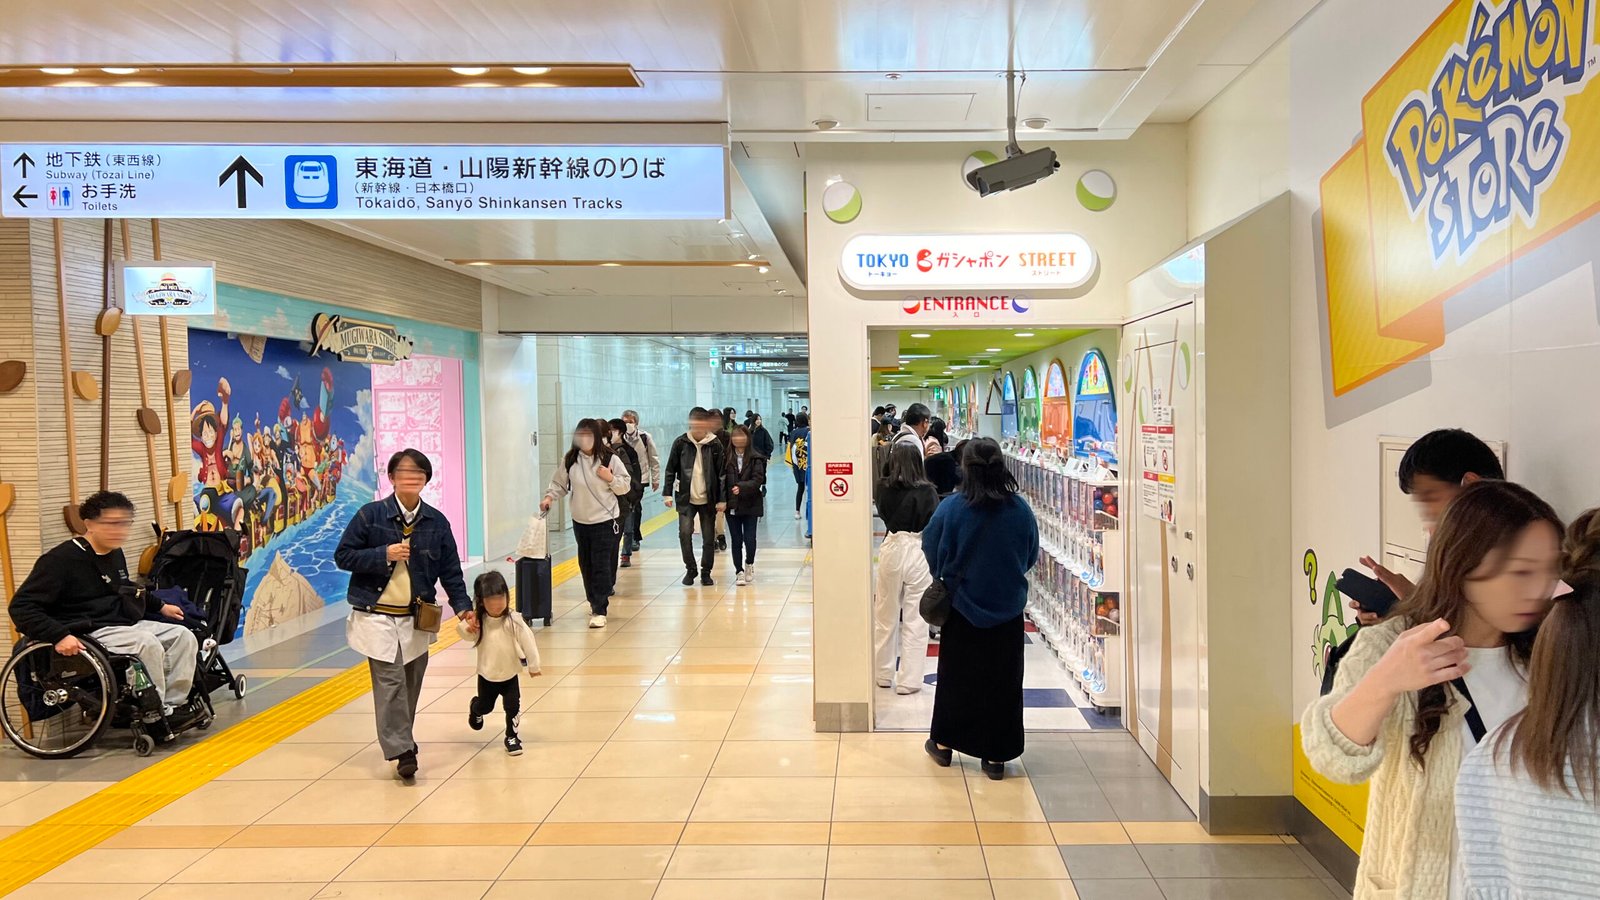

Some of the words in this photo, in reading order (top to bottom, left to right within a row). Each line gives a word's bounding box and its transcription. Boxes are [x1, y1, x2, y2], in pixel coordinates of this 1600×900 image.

[46, 170, 87, 180] Subway
[128, 170, 155, 180] Line)
[355, 156, 666, 180] 東海道・山陽新幹線のりば
[82, 183, 136, 199] お手洗
[83, 202, 118, 211] Toilets
[356, 196, 420, 211] Tōkaidō,
[426, 196, 473, 211] Sanyō
[479, 196, 567, 209] Shinkansen
[573, 196, 623, 209] Tracks
[856, 253, 909, 268] TOKYO
[936, 250, 1010, 268] ガシャポン
[1019, 252, 1077, 267] STREET
[923, 296, 1009, 311] ENTRANCE
[341, 327, 378, 348] MUGIWARA
[379, 330, 397, 357] STORE
